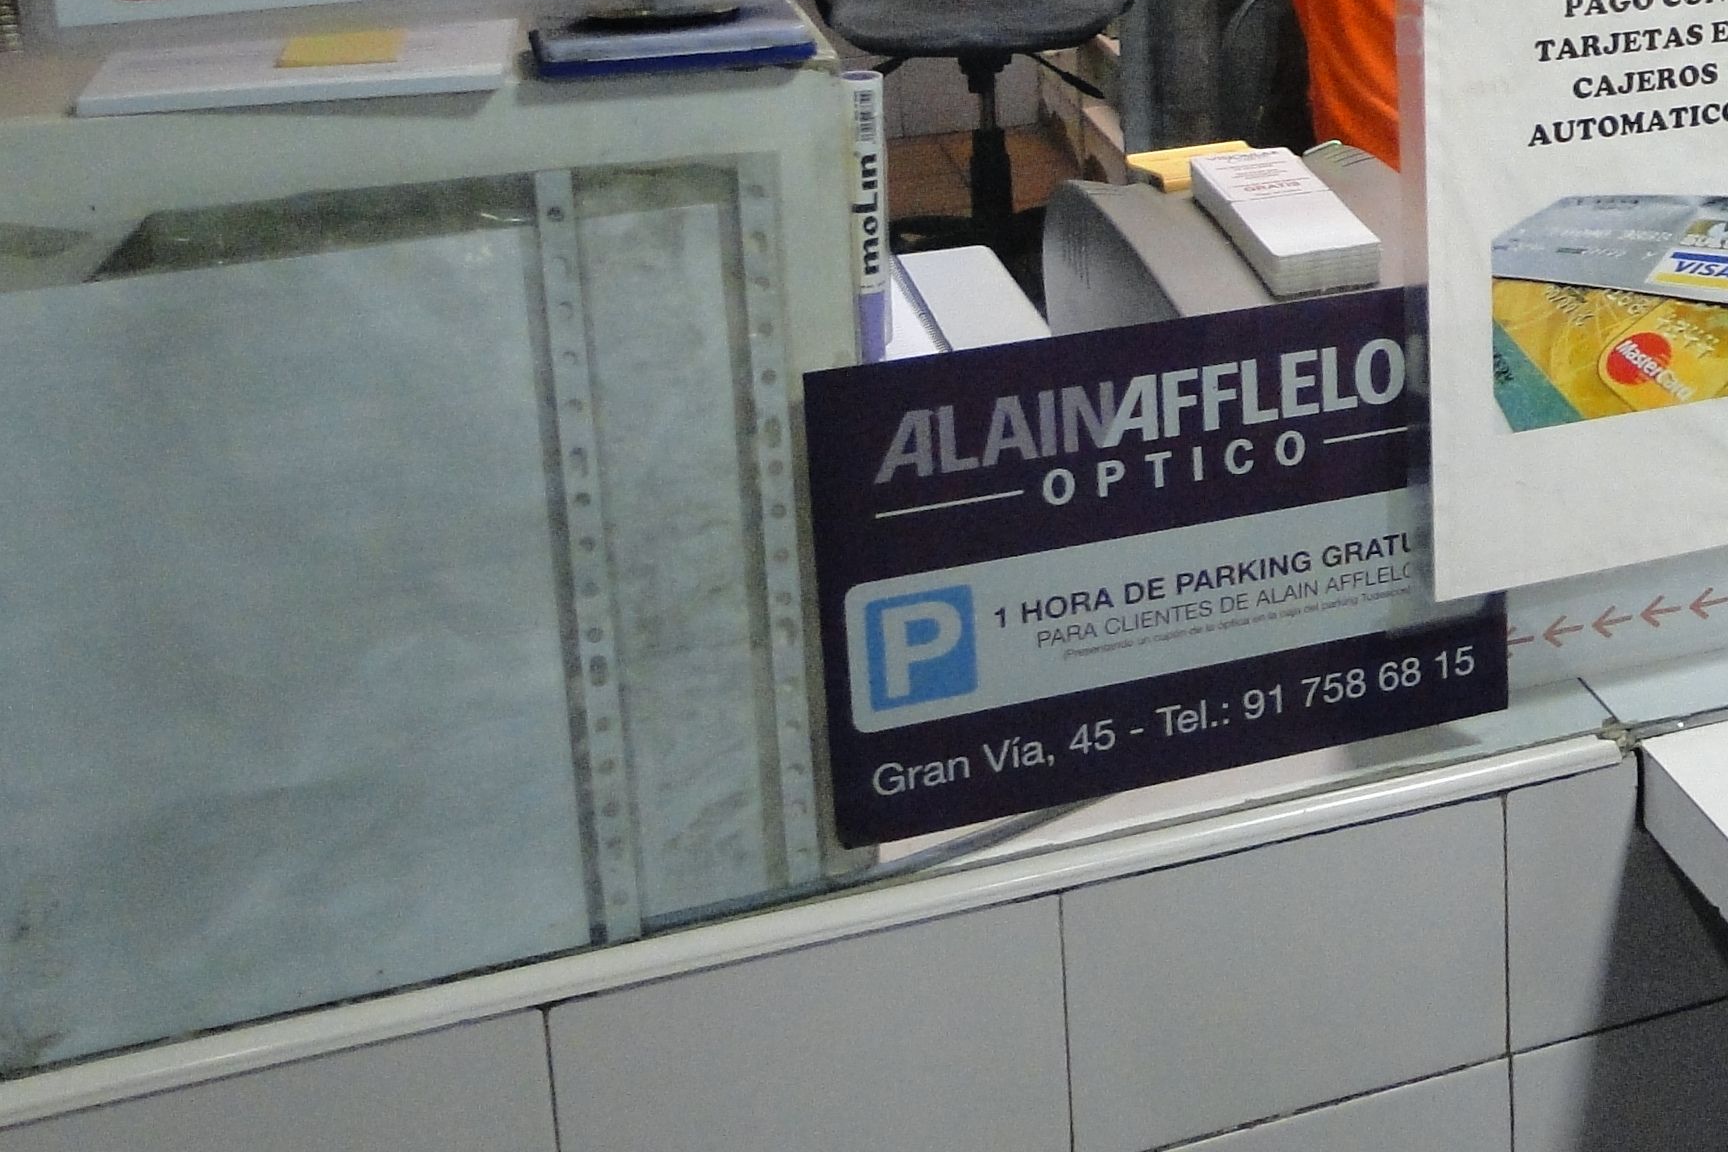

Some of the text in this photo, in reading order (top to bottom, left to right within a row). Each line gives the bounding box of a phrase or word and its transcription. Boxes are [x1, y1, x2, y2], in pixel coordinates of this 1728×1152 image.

[1535, 24, 1704, 62] TARJETAS
[1573, 63, 1718, 99] CAJEROS
[851, 154, 880, 275] moLin
[1615, 339, 1698, 401] MasterCard
[1042, 430, 1306, 506] OPTICO
[994, 606, 1006, 628] 1
[1021, 587, 1114, 624] HORA
[1124, 577, 1166, 605] DE
[1176, 550, 1312, 595] PARKING
[1036, 622, 1098, 648] PARA
[1104, 600, 1213, 635] CLIENTES
[1220, 593, 1249, 614] DE
[1256, 579, 1319, 607] ALAIN
[872, 755, 970, 796] Gran
[983, 736, 1055, 768] Vía,
[1069, 719, 1116, 754] 45
[1155, 699, 1229, 737] Tel.:
[1243, 684, 1282, 720] 91
[1301, 668, 1366, 708] 758
[1378, 657, 1421, 691] 68
[1435, 646, 1475, 680] 15
